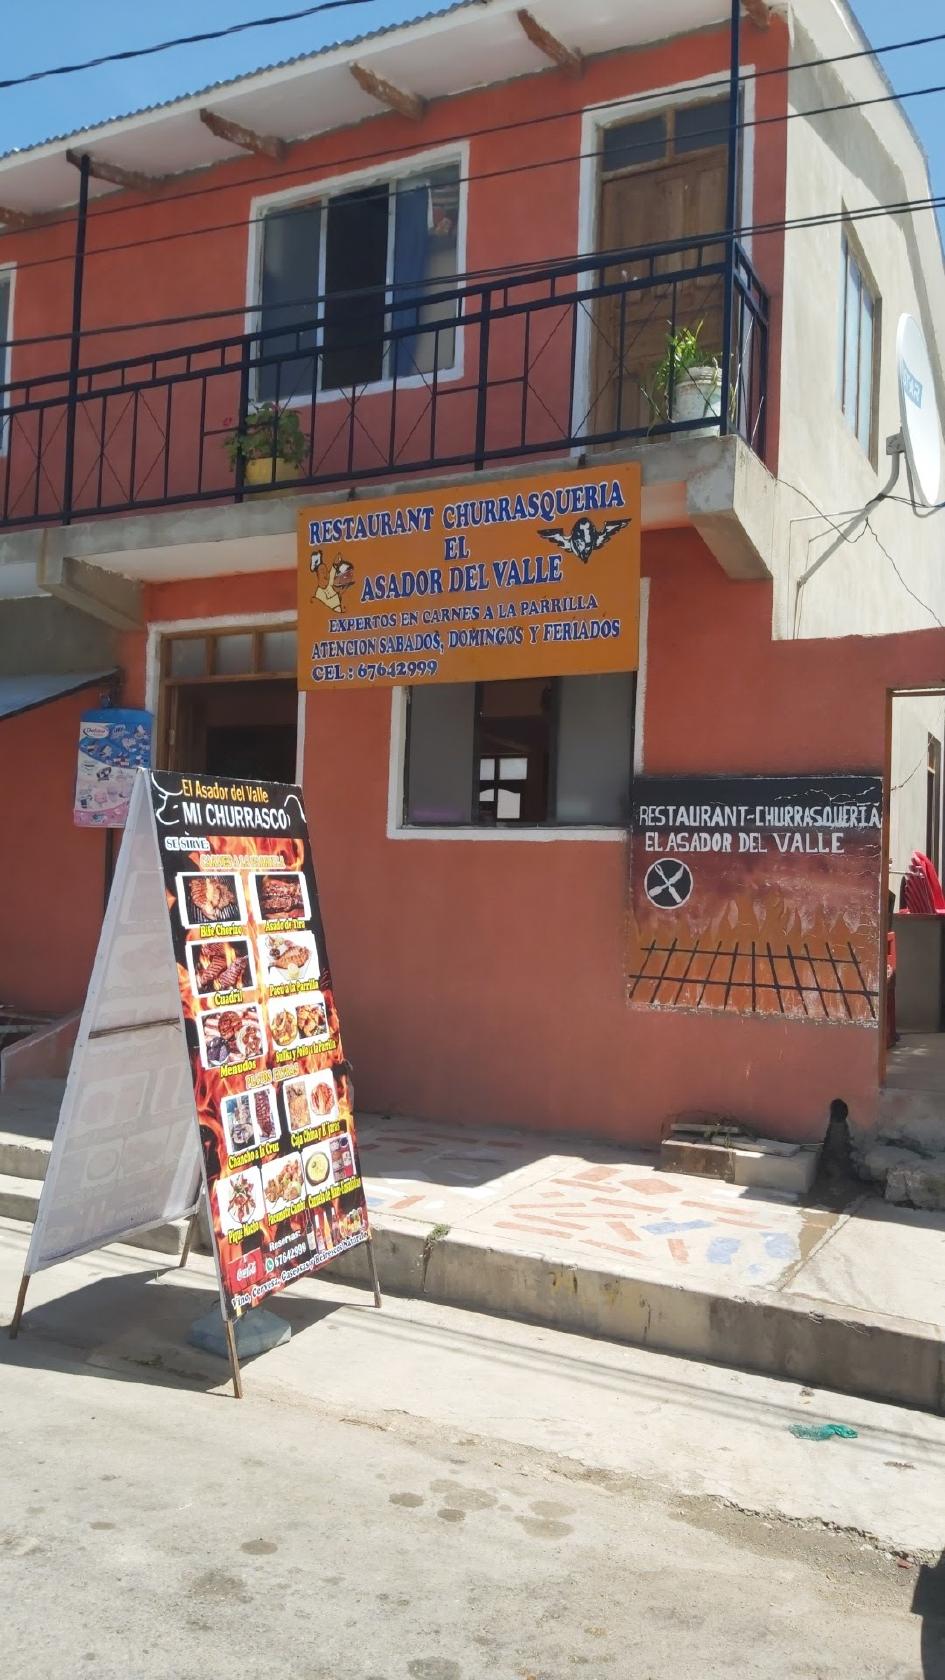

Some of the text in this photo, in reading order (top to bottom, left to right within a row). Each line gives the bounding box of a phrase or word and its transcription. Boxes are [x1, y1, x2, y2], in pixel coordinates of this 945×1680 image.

[309, 480, 625, 546] RESTAURANT CHURRASQUERIA
[444, 536, 469, 561] EL
[360, 554, 563, 602] ASADOR DEL VALLE
[328, 594, 599, 633] EXPERTOS EN CARNES A LA PARRILLA
[311, 618, 621, 660] ATENCION SABADOS, DOMINGOS Y FERIADOS
[357, 660, 438, 680] 67642999
[181, 779, 270, 804] El Asador del Valle
[181, 801, 288, 830] MI CHURRASCO
[166, 837, 179, 850] SE
[645, 832, 845, 854] EL ASADOR DEL VALLE
[220, 1059, 257, 1077] Menudos
[228, 1149, 255, 1171] Chancho
[265, 1141, 280, 1155] Cruz
